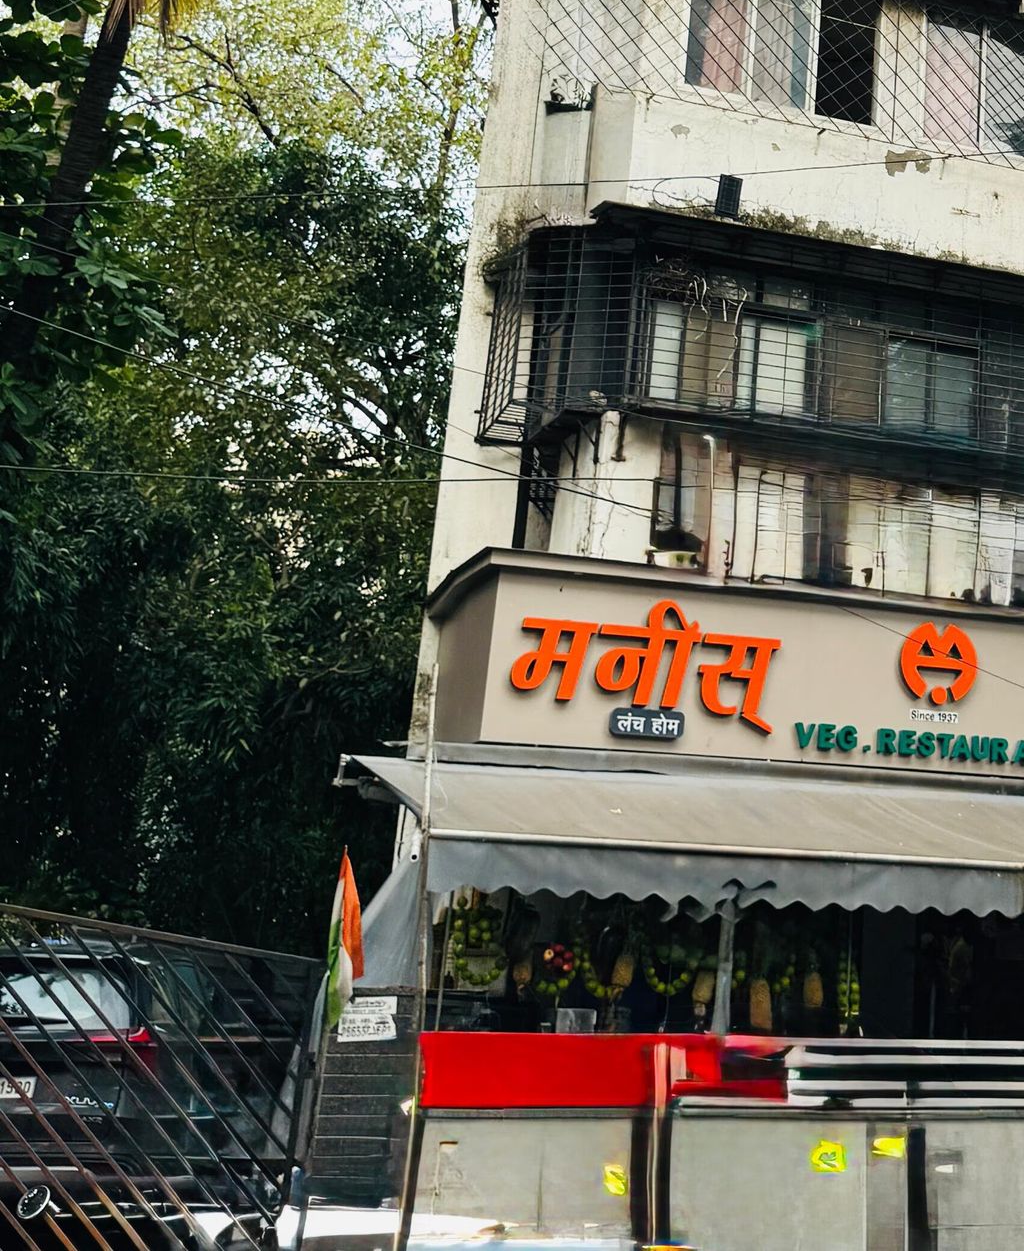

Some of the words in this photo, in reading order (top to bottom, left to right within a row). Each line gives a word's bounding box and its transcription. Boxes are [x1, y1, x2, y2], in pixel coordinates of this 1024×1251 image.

[616, 712, 645, 733] लंच
[651, 713, 681, 736] होम
[910, 709, 935, 721] Since
[937, 712, 958, 723] 1937
